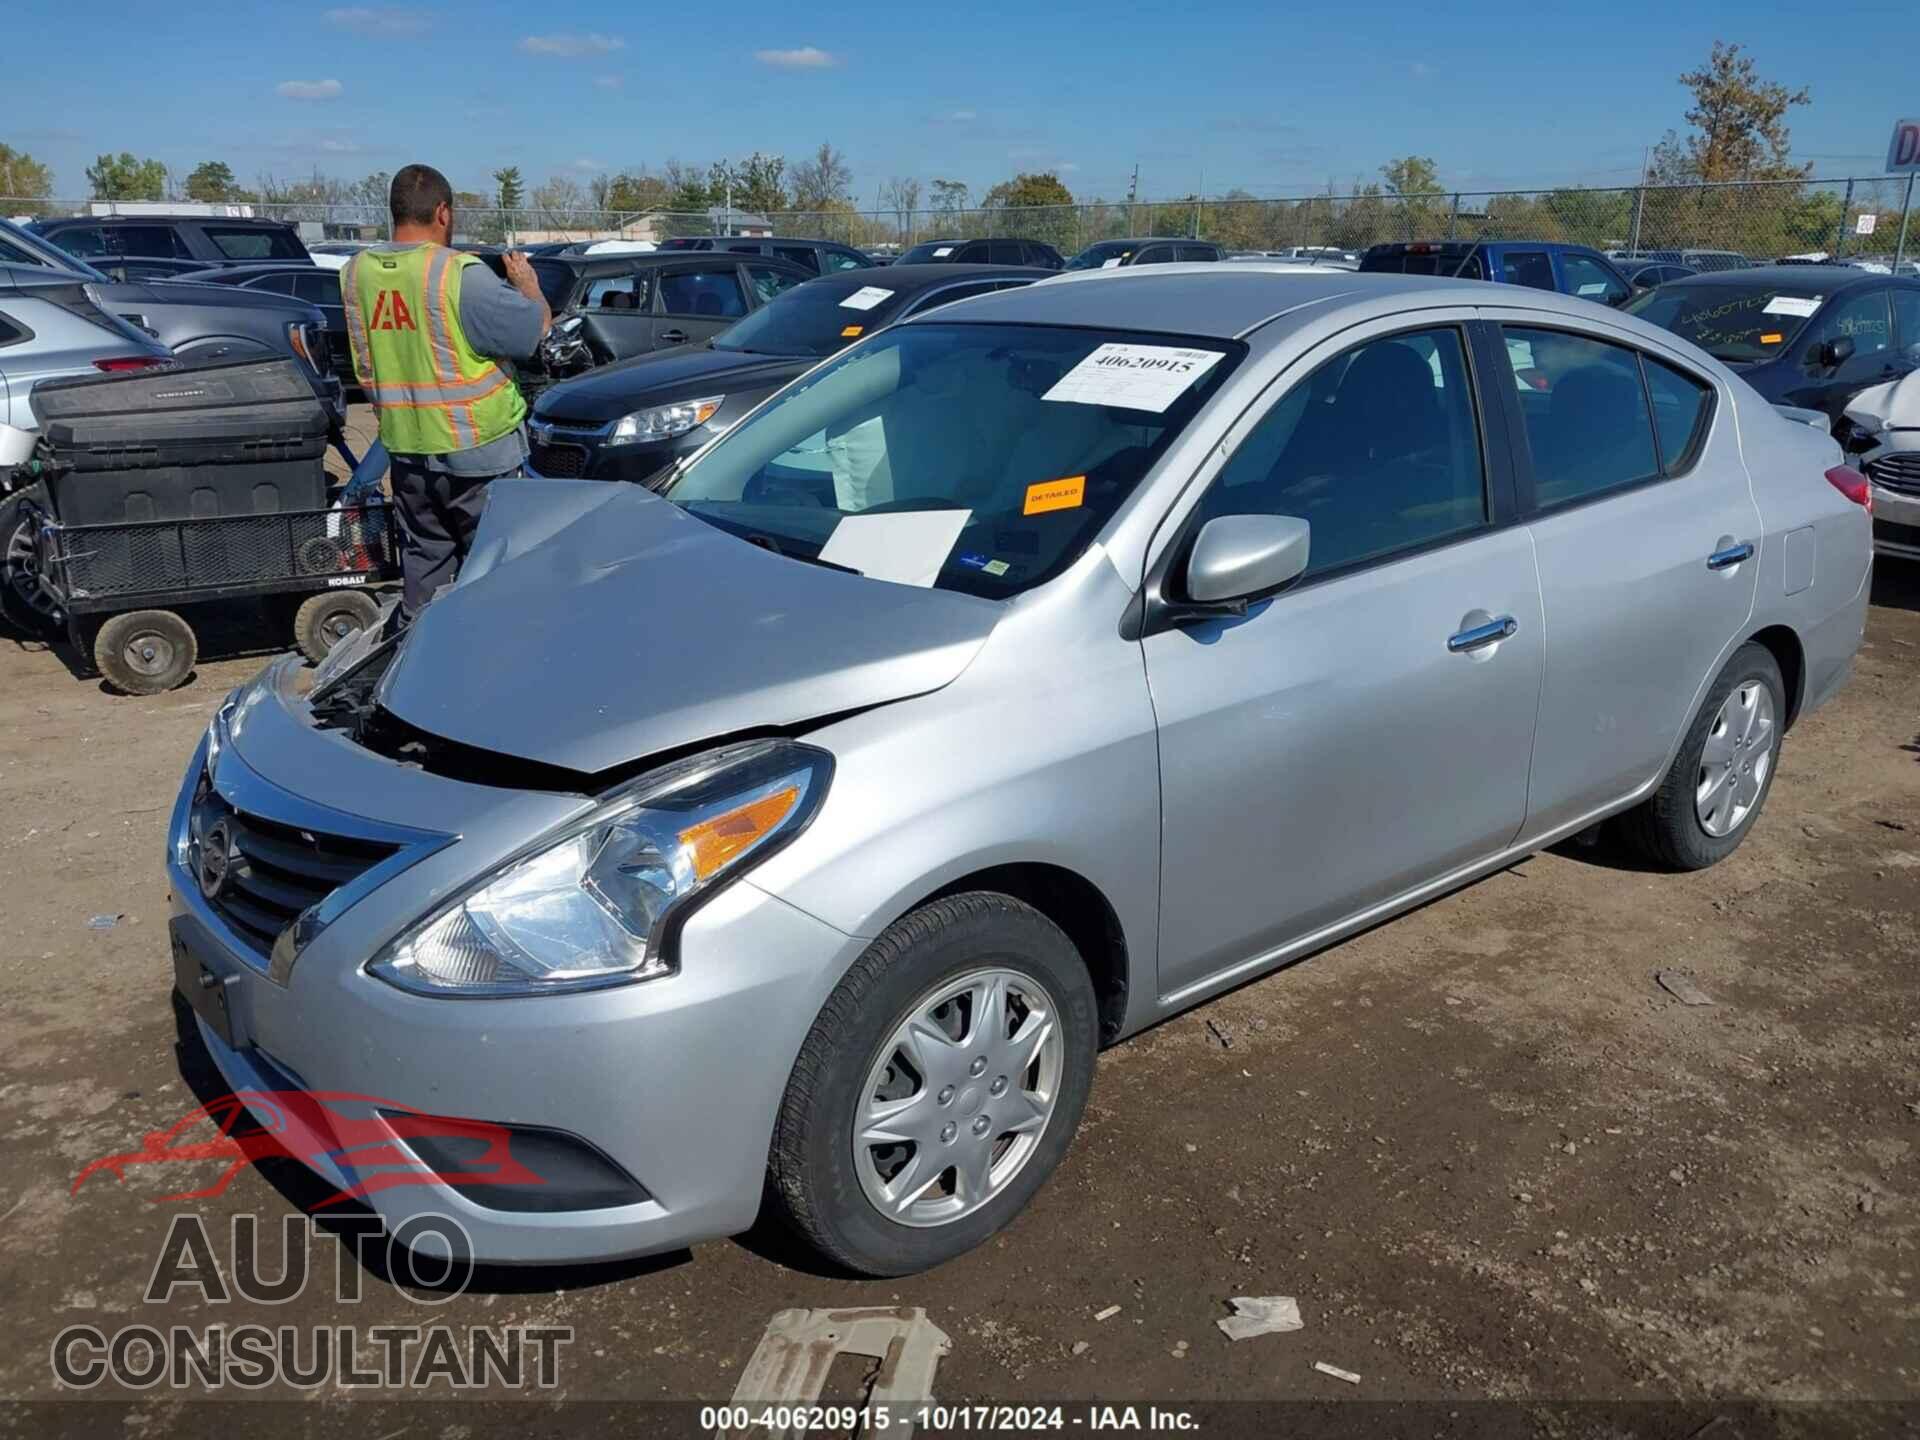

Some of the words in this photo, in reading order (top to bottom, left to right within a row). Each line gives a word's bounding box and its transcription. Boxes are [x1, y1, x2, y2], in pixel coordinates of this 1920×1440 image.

[1895, 125, 1920, 166] D
[1095, 354, 1196, 374] 40620915
[327, 575, 367, 587] KOBALT
